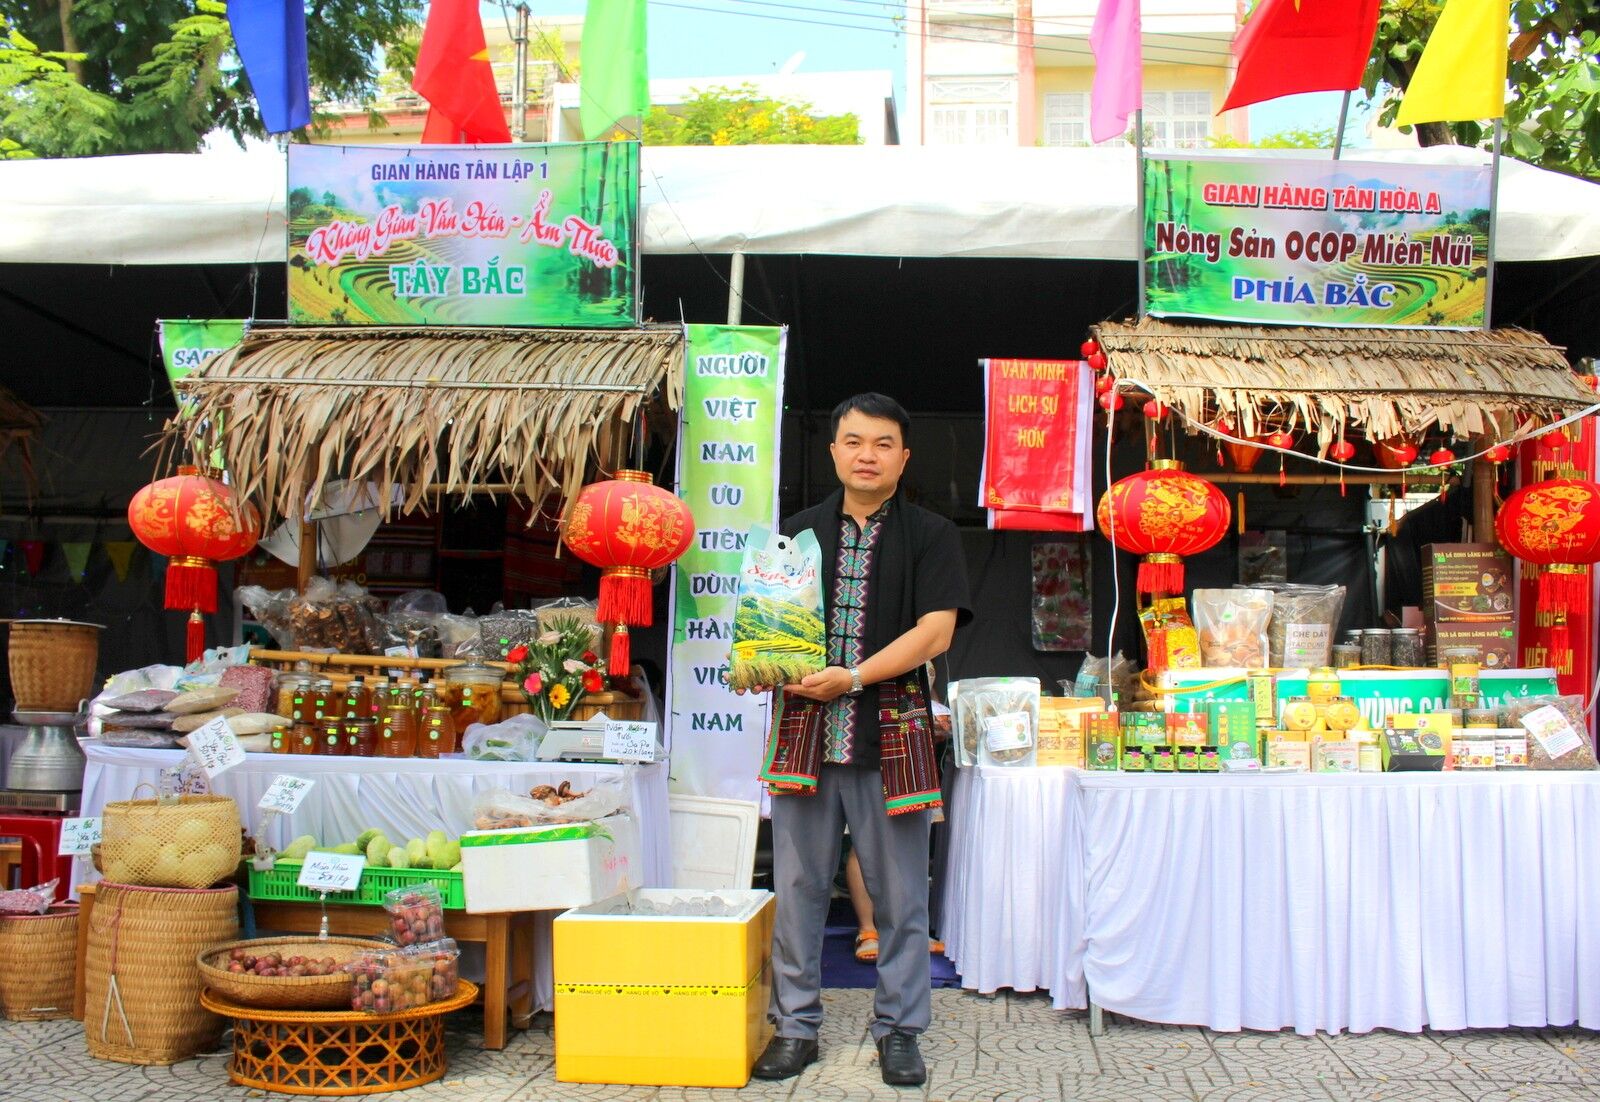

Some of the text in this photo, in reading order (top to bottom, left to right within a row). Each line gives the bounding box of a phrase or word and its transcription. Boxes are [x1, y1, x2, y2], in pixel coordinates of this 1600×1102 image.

[371, 159, 548, 183] GIAN HÀNG TÂN LẬP 1
[1203, 182, 1441, 213] GIAN HÀNG TÂN HÒA A
[308, 225, 371, 261] Không
[375, 206, 416, 251] Gian
[462, 200, 505, 233] Hóa
[521, 190, 560, 241] Ẩm
[565, 216, 615, 261] Thực
[1157, 223, 1473, 266] Nông Sản OCOP Miền Núi
[391, 256, 525, 295] TÂY BẮC
[1234, 275, 1394, 308] PHÍA BẮC
[698, 354, 767, 376] NGƯỜI
[705, 398, 757, 421] VIỆT
[702, 443, 755, 462] NAM
[711, 484, 742, 505] ƯU
[693, 574, 740, 594] DÙN
[688, 617, 734, 640] HÀN
[694, 665, 730, 690] VIỆ
[692, 713, 743, 731] NAM
